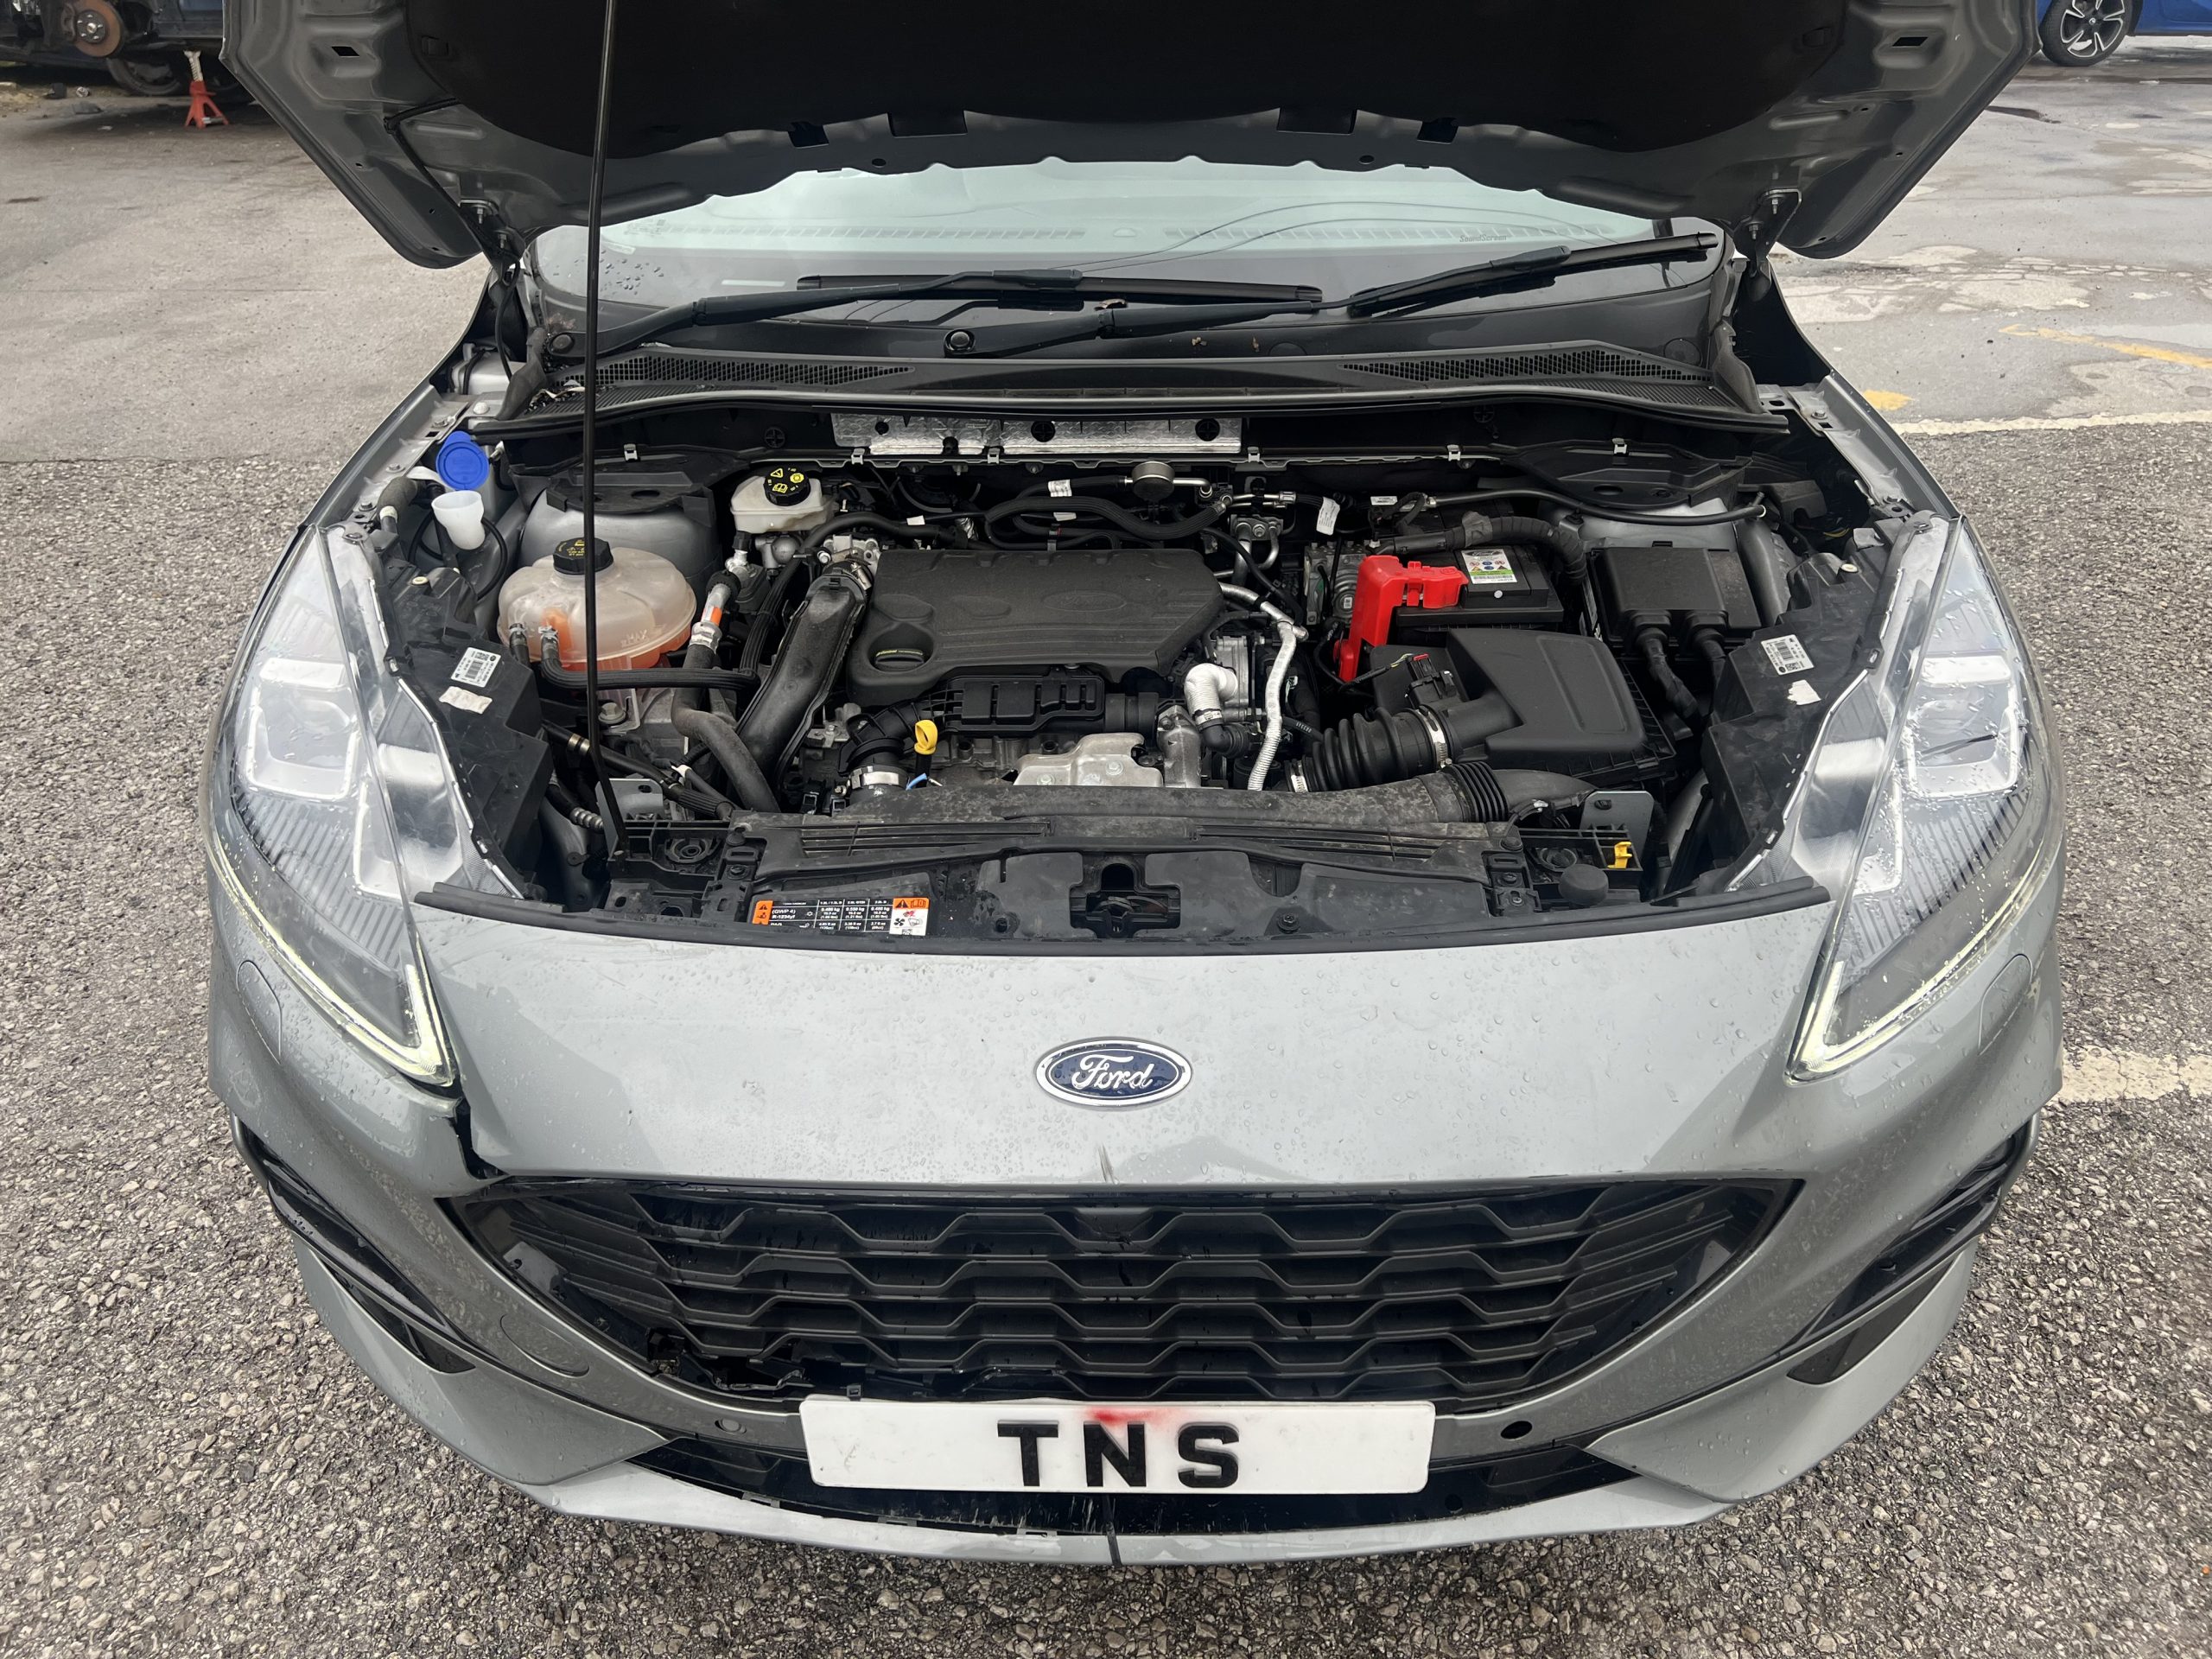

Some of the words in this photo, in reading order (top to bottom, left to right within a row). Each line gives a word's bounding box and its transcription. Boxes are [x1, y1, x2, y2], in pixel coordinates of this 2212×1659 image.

[1459, 233, 1508, 243] SoundScreen
[1071, 1053, 1154, 1090] Ford
[996, 1419, 1241, 1489] TNS
